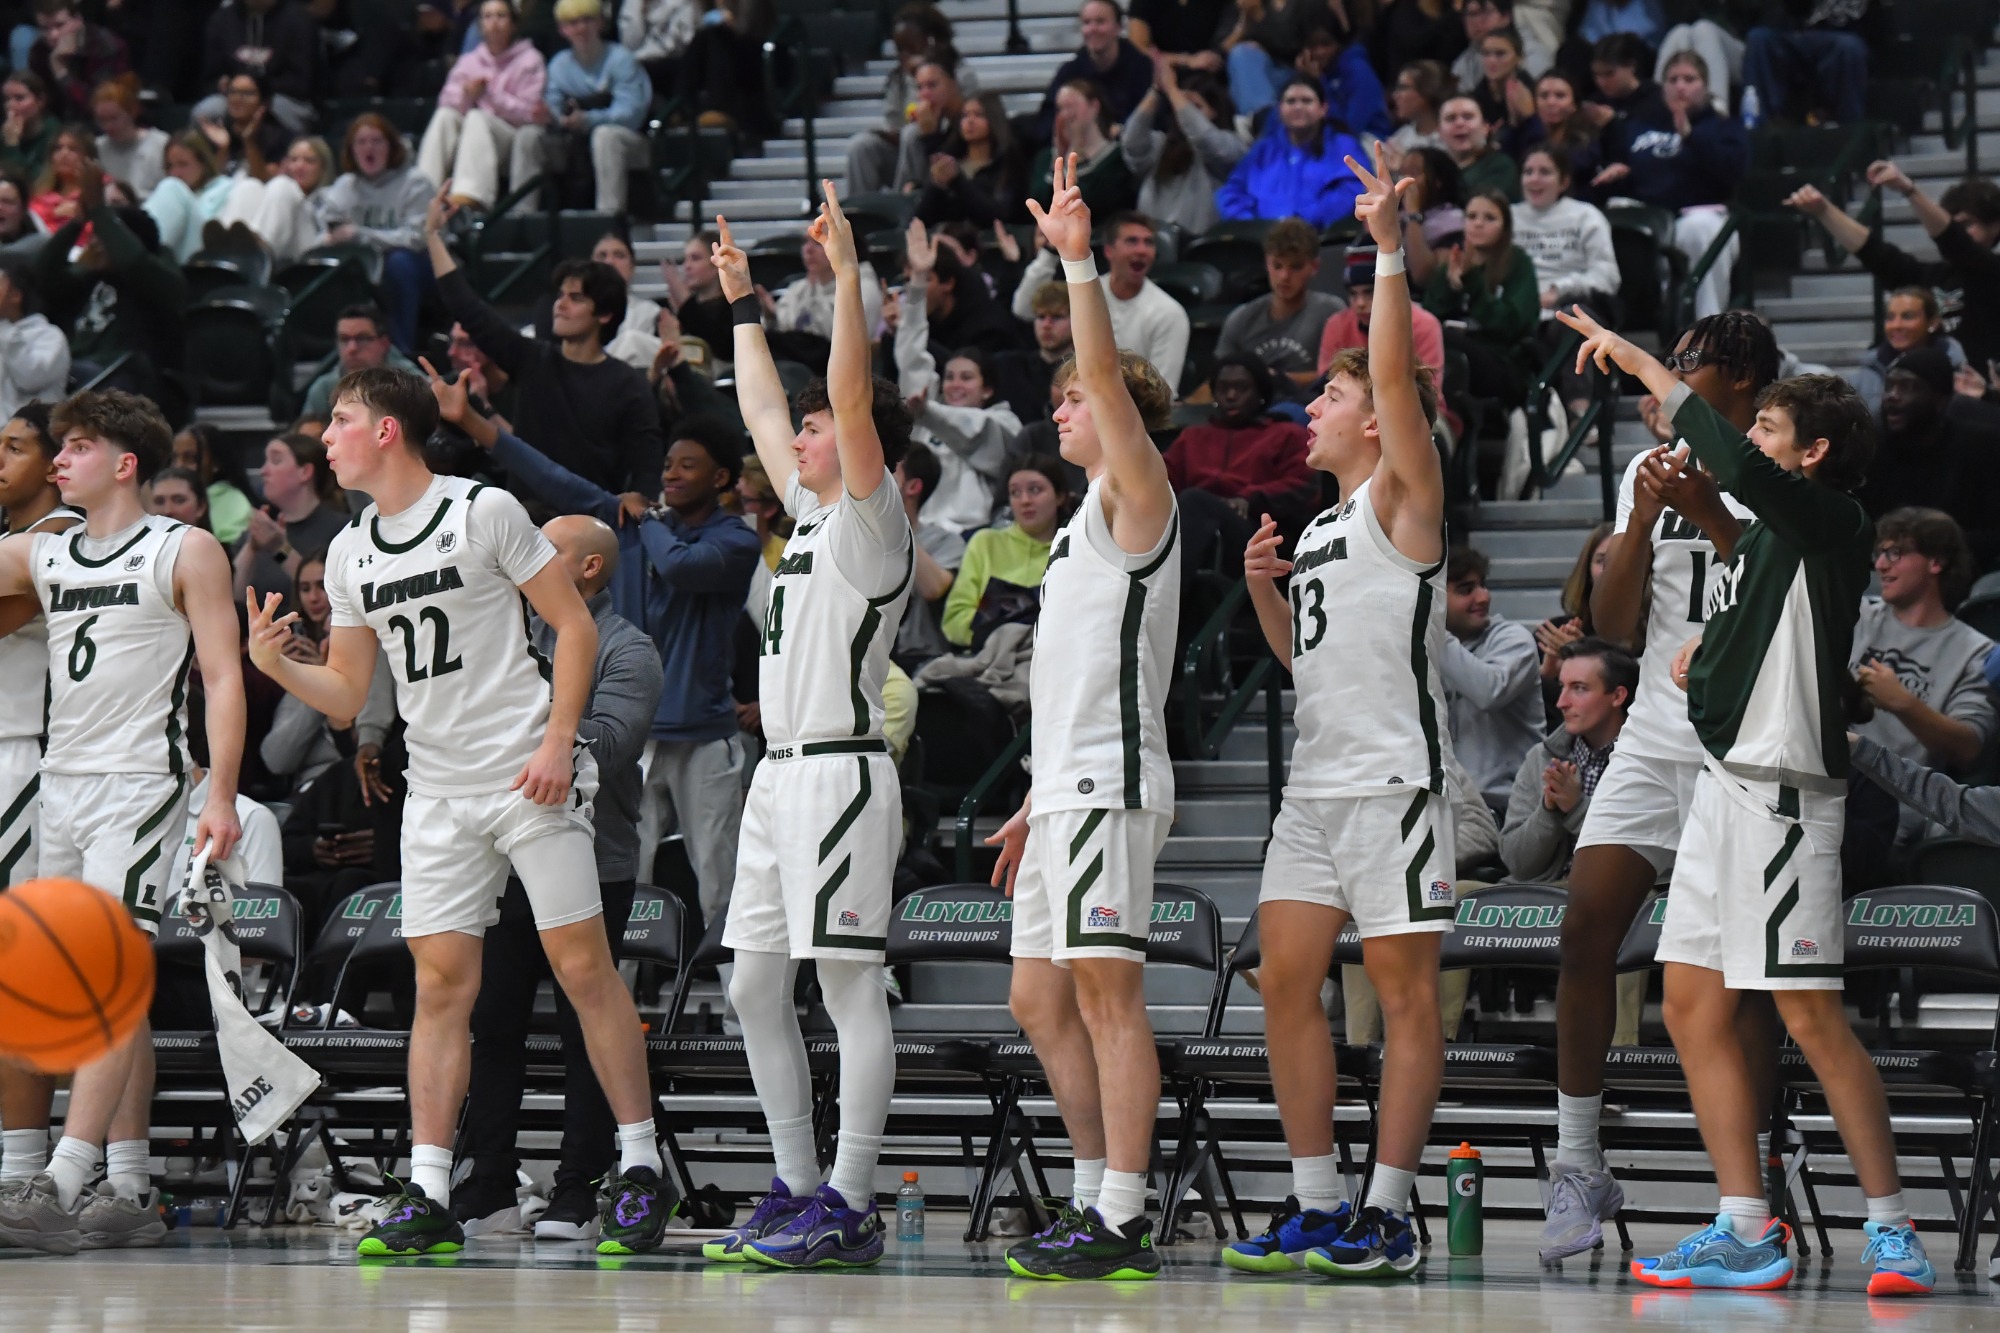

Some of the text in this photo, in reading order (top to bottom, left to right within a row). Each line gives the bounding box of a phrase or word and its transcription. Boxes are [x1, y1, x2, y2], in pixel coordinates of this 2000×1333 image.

[361, 565, 464, 614] LOYOLA
[49, 582, 140, 613] LOYOLA
[1291, 577, 1327, 659] 13
[68, 614, 99, 682] 6
[387, 605, 463, 683] 22
[900, 895, 1013, 923] LOYOLA
[1150, 901, 1196, 923] OLA
[1847, 897, 1976, 927] LOYOLA
[908, 930, 999, 942] GREYHOUNDS
[1463, 935, 1561, 948] GREYHOUNDS
[1857, 935, 1962, 948] GREYHOUNDS
[153, 1037, 200, 1048] HOUNDS
[284, 1037, 404, 1048] LOYOLA GREYHOUNDS
[645, 1040, 747, 1052] YOLA GREYHOUN
[810, 1042, 935, 1054] LOYO OUNDS
[997, 1044, 1034, 1055] LOYOL
[1184, 1045, 1229, 1056] LOYOLA
[1444, 1050, 1515, 1062] EYHOUNDS
[1455, 1173, 1476, 1197] G
